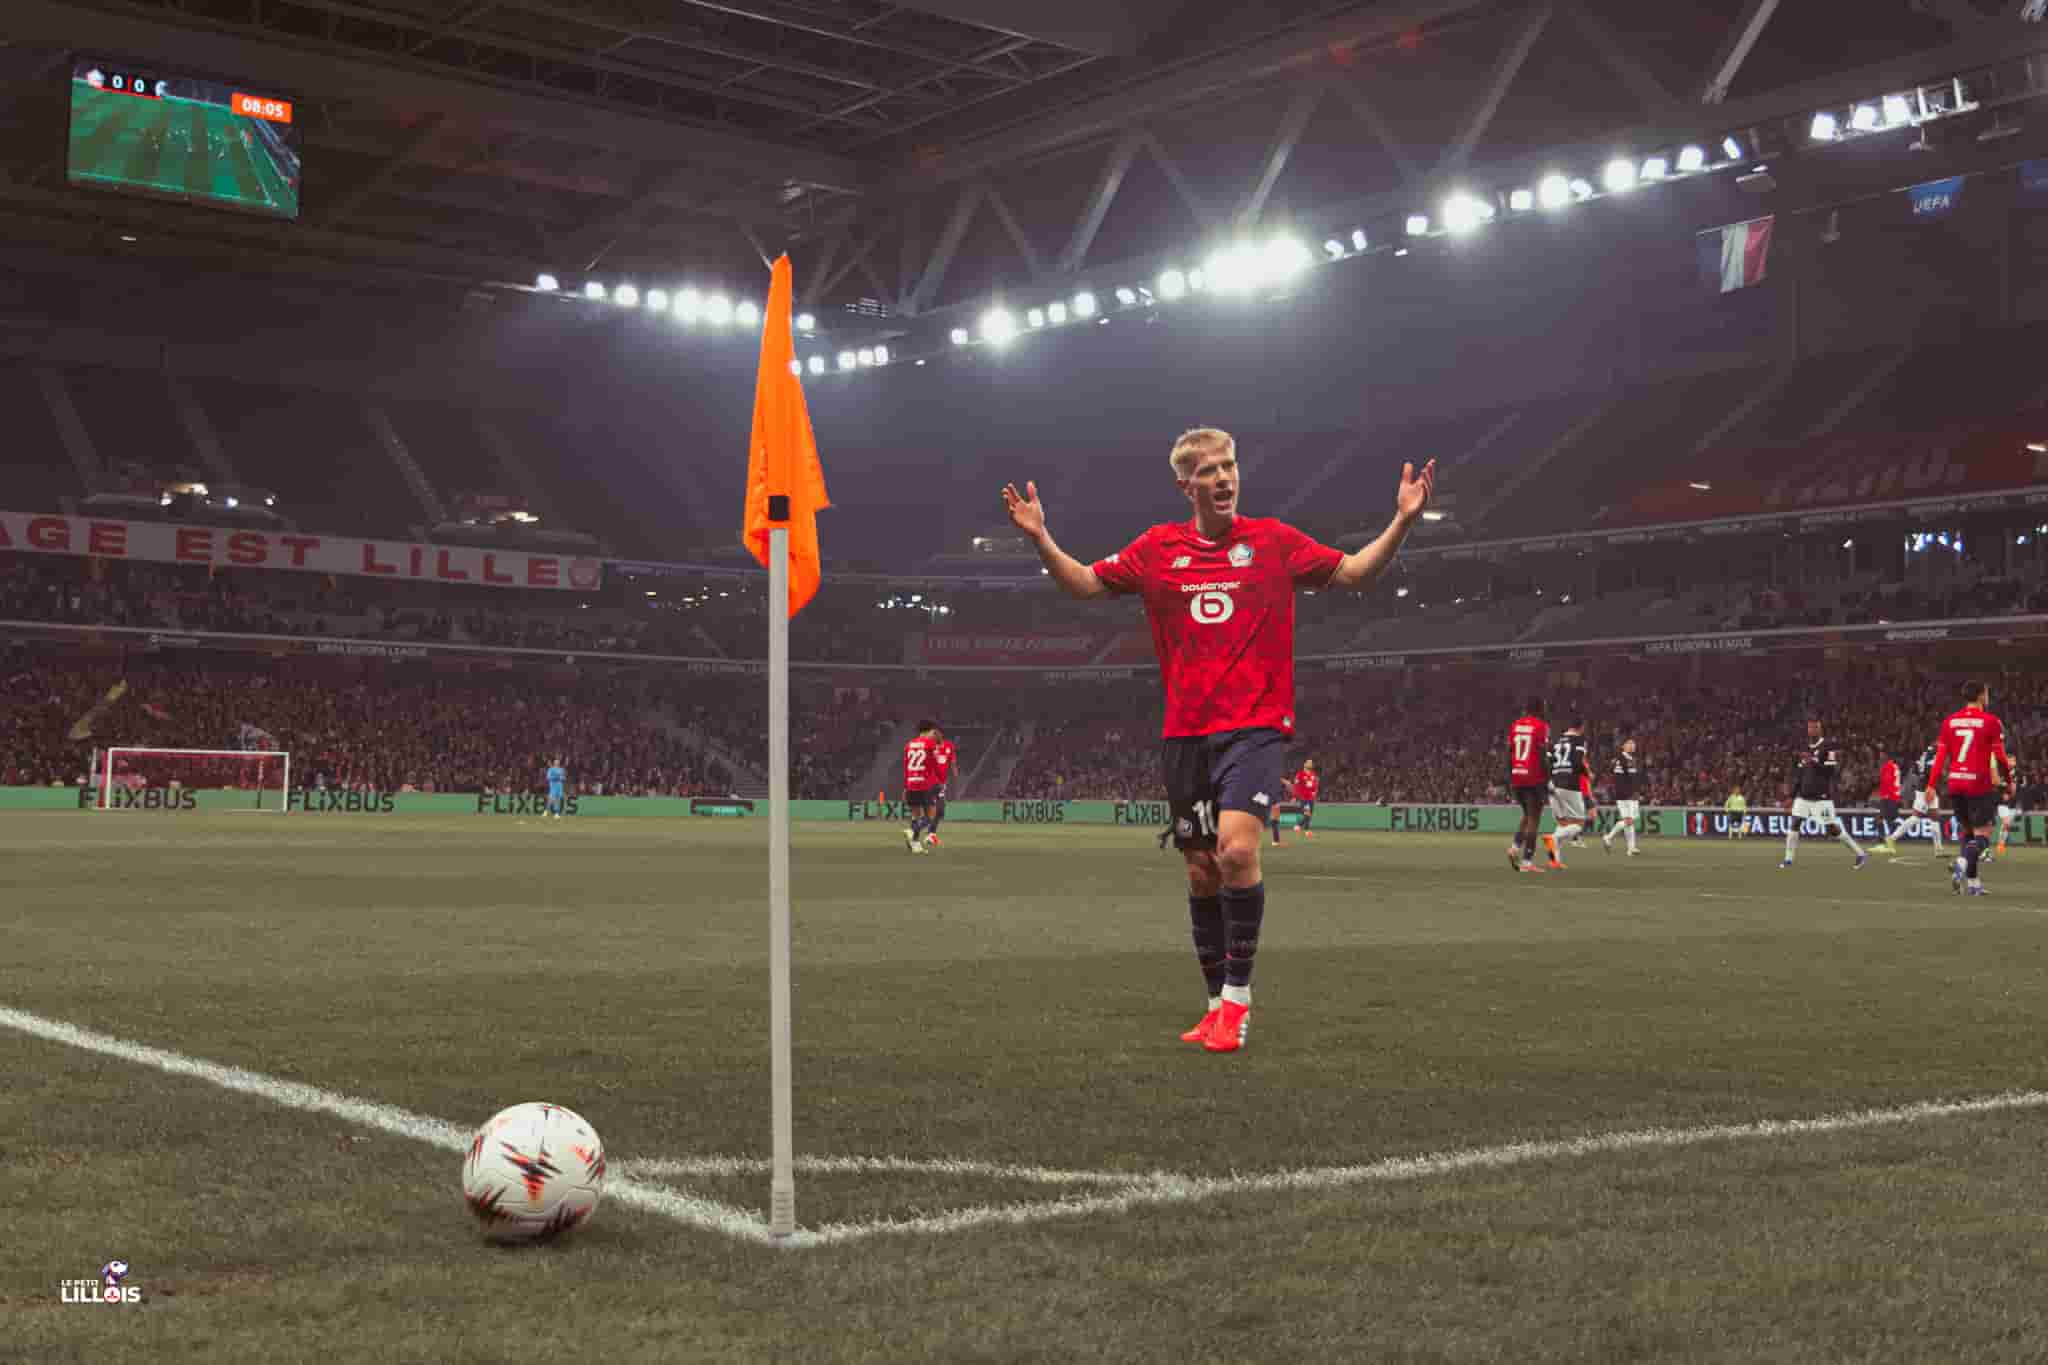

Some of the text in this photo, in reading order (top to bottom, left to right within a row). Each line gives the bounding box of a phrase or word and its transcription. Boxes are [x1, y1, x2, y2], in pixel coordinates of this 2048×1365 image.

[112, 75, 145, 93] 0 0
[241, 97, 284, 118] 08:05
[1912, 192, 1951, 215] UEFA
[0, 518, 560, 586] GE EST LILLE
[1181, 582, 1241, 593] boulanger
[1513, 734, 1532, 761] 17
[1553, 742, 1572, 767] 32
[1954, 728, 1974, 763] 7
[907, 749, 927, 771] 22
